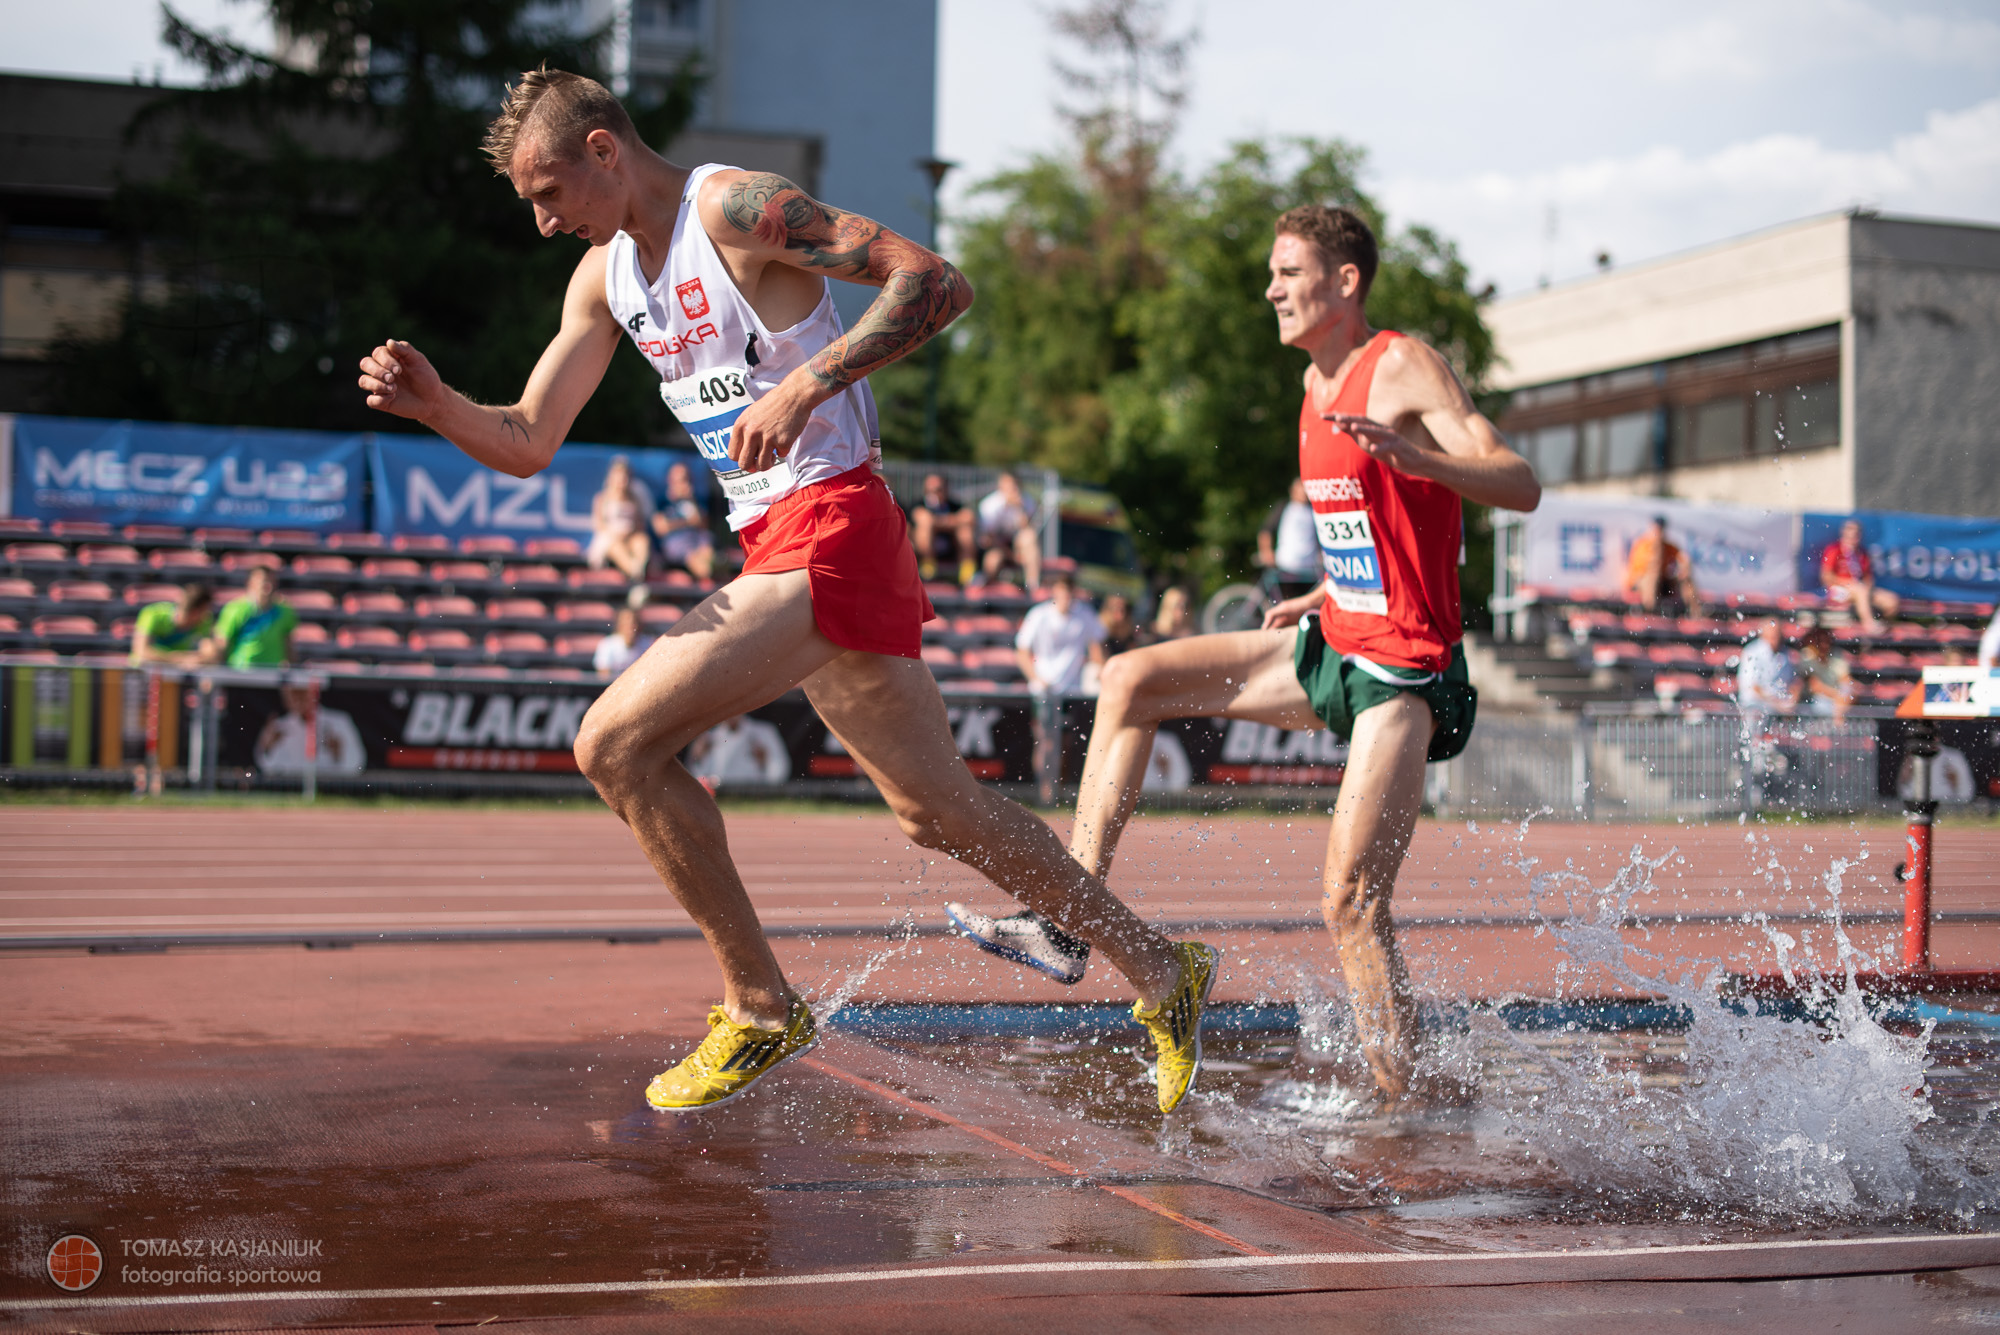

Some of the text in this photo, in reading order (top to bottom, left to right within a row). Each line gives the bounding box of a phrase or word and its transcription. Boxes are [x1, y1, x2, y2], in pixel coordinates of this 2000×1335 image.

[677, 279, 700, 293] POLSKA
[628, 312, 647, 333] 4F
[700, 373, 746, 407] 403
[34, 446, 349, 502] MECZ U23
[745, 477, 770, 494] 2018
[1324, 520, 1367, 541] 331
